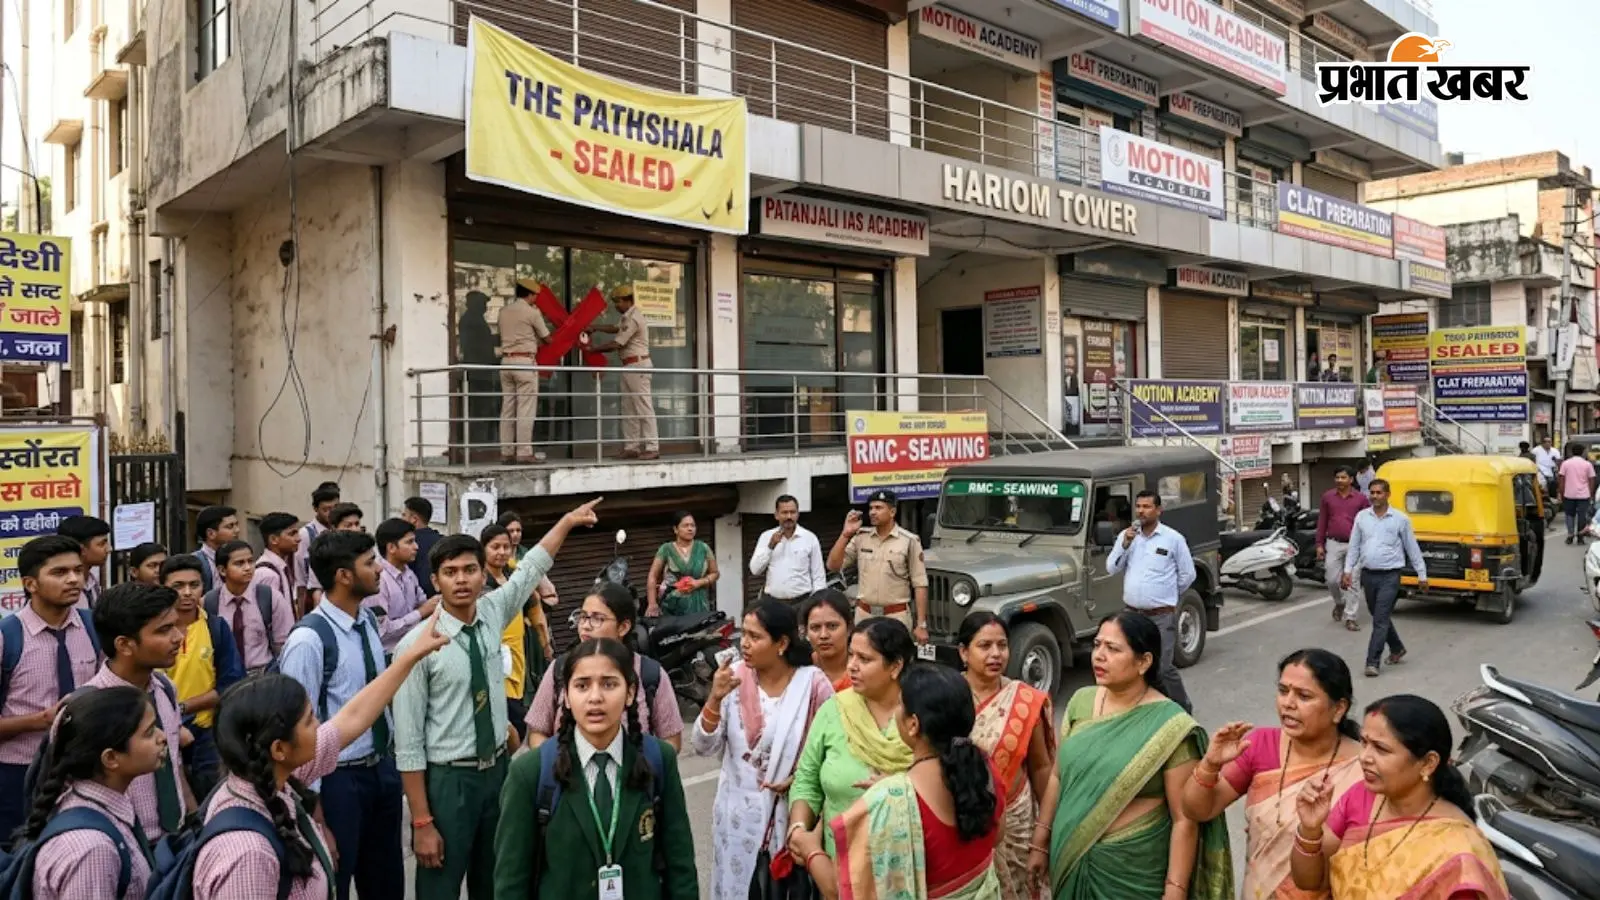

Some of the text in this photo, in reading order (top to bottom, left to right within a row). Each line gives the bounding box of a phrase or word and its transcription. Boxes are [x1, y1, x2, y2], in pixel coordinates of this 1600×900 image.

[922, 6, 976, 39] MOTION
[1071, 52, 1096, 74] CLAT
[505, 69, 723, 158] THE PATHSHALA
[574, 139, 674, 192] SEALED
[1128, 140, 1210, 188] MOTION
[765, 197, 838, 229] PATANJALI
[843, 209, 864, 232] IAS
[867, 213, 926, 240] ACADEMY
[943, 163, 1050, 218] HARIOM
[1059, 189, 1138, 235] TOWER
[1287, 188, 1323, 218] CLAT
[1326, 201, 1391, 236] PREPARATION
[1436, 342, 1520, 358] SEALED
[1437, 377, 1461, 388] CLAT
[968, 482, 993, 494] RMC
[1003, 483, 1058, 496] SEAWING
